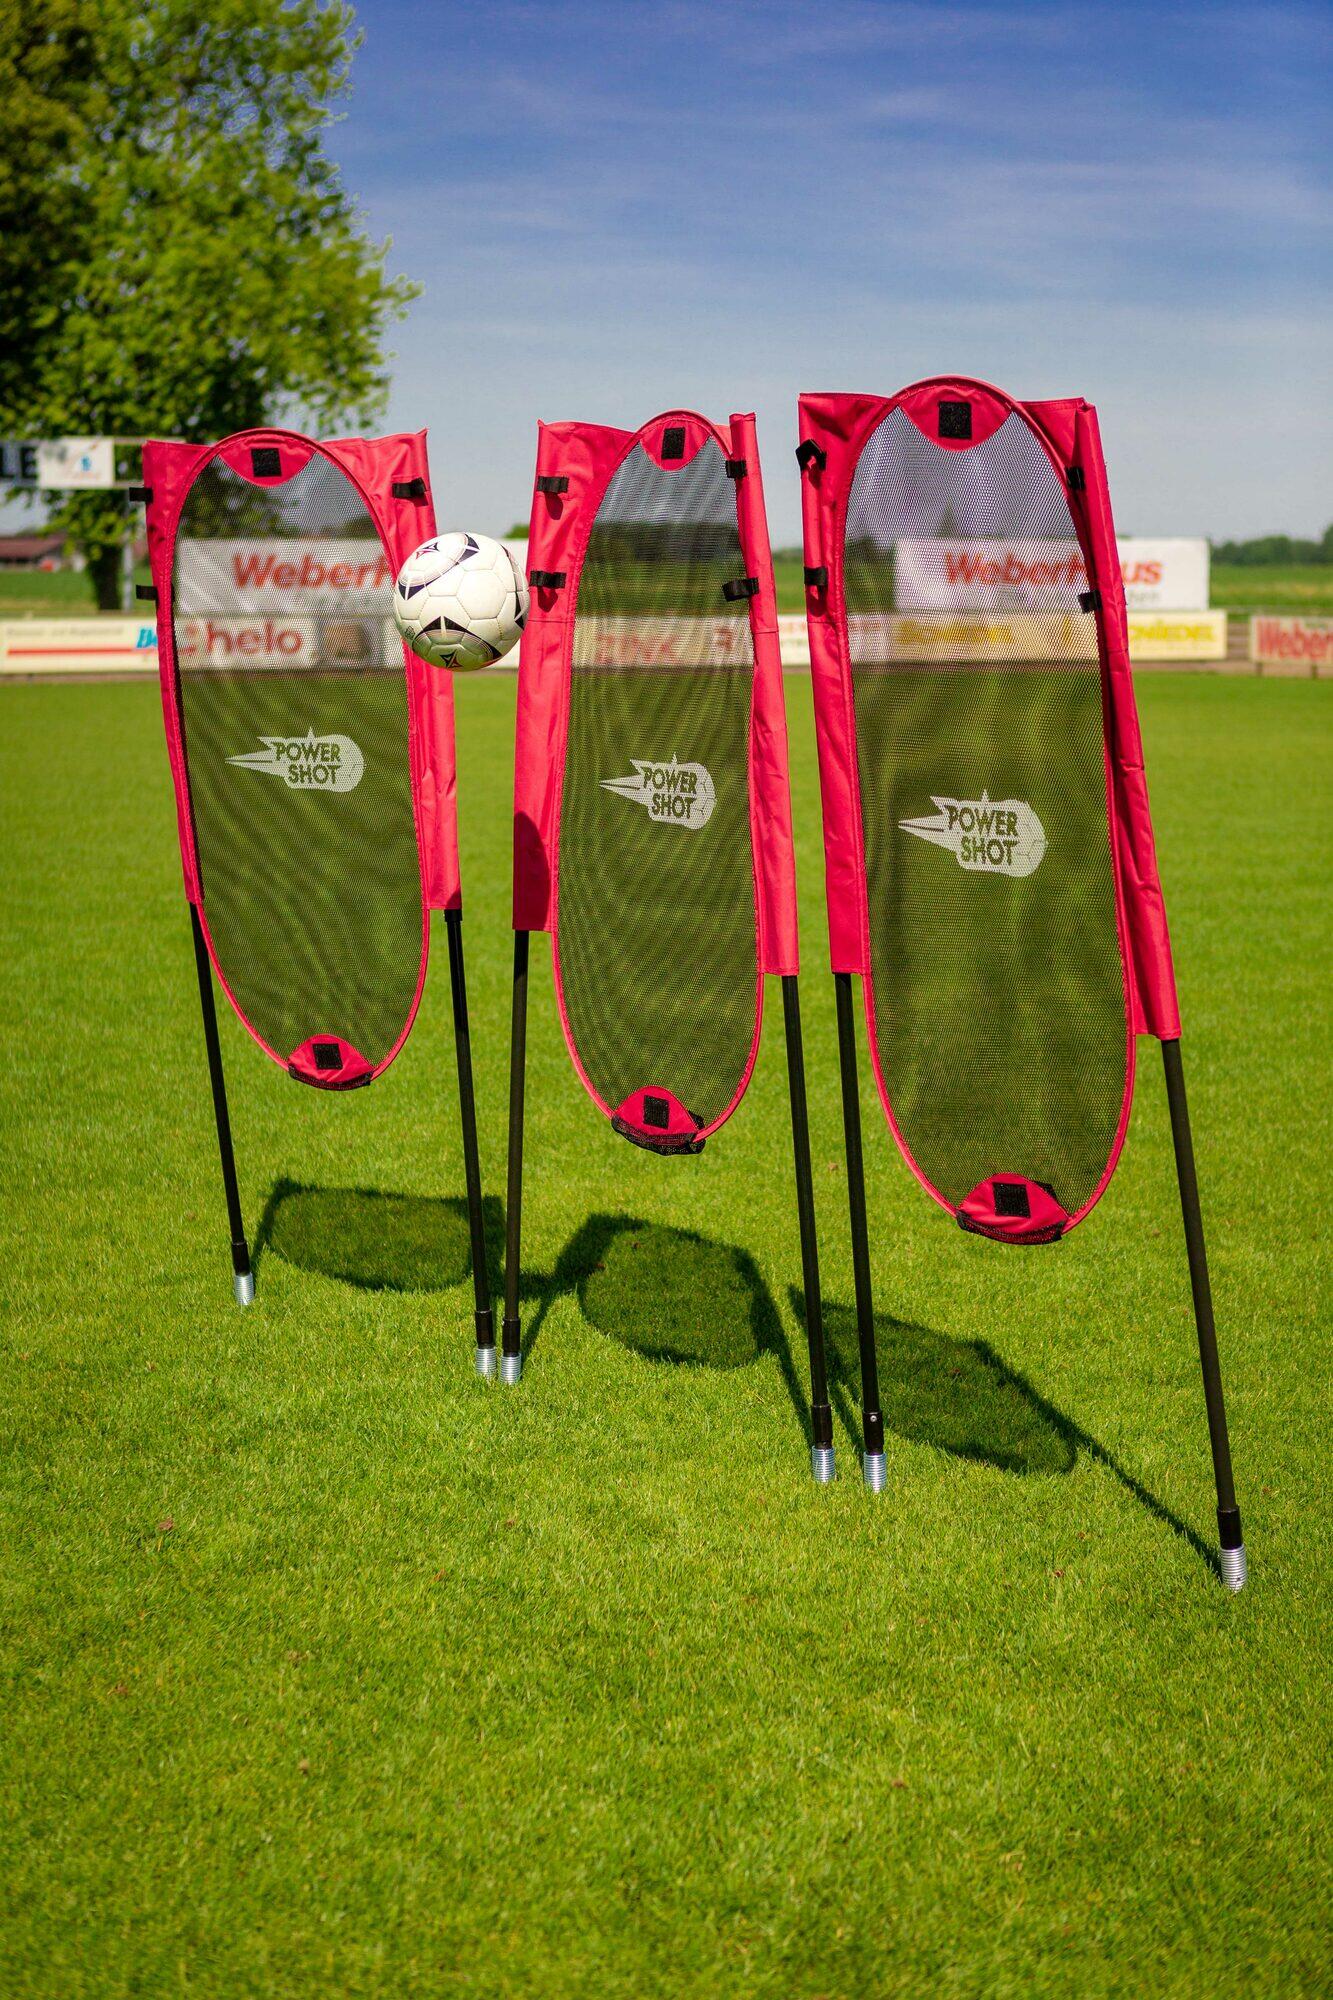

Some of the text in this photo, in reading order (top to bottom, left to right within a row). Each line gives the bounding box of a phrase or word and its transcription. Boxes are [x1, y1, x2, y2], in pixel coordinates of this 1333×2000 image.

[946, 553, 1163, 585] Weberhus
[270, 741, 341, 763] POWER
[288, 763, 341, 785] SHOT
[640, 766, 698, 794] POWER
[652, 792, 697, 819] SHOT
[944, 804, 1019, 838] POWER
[960, 835, 1019, 866] SHOT
